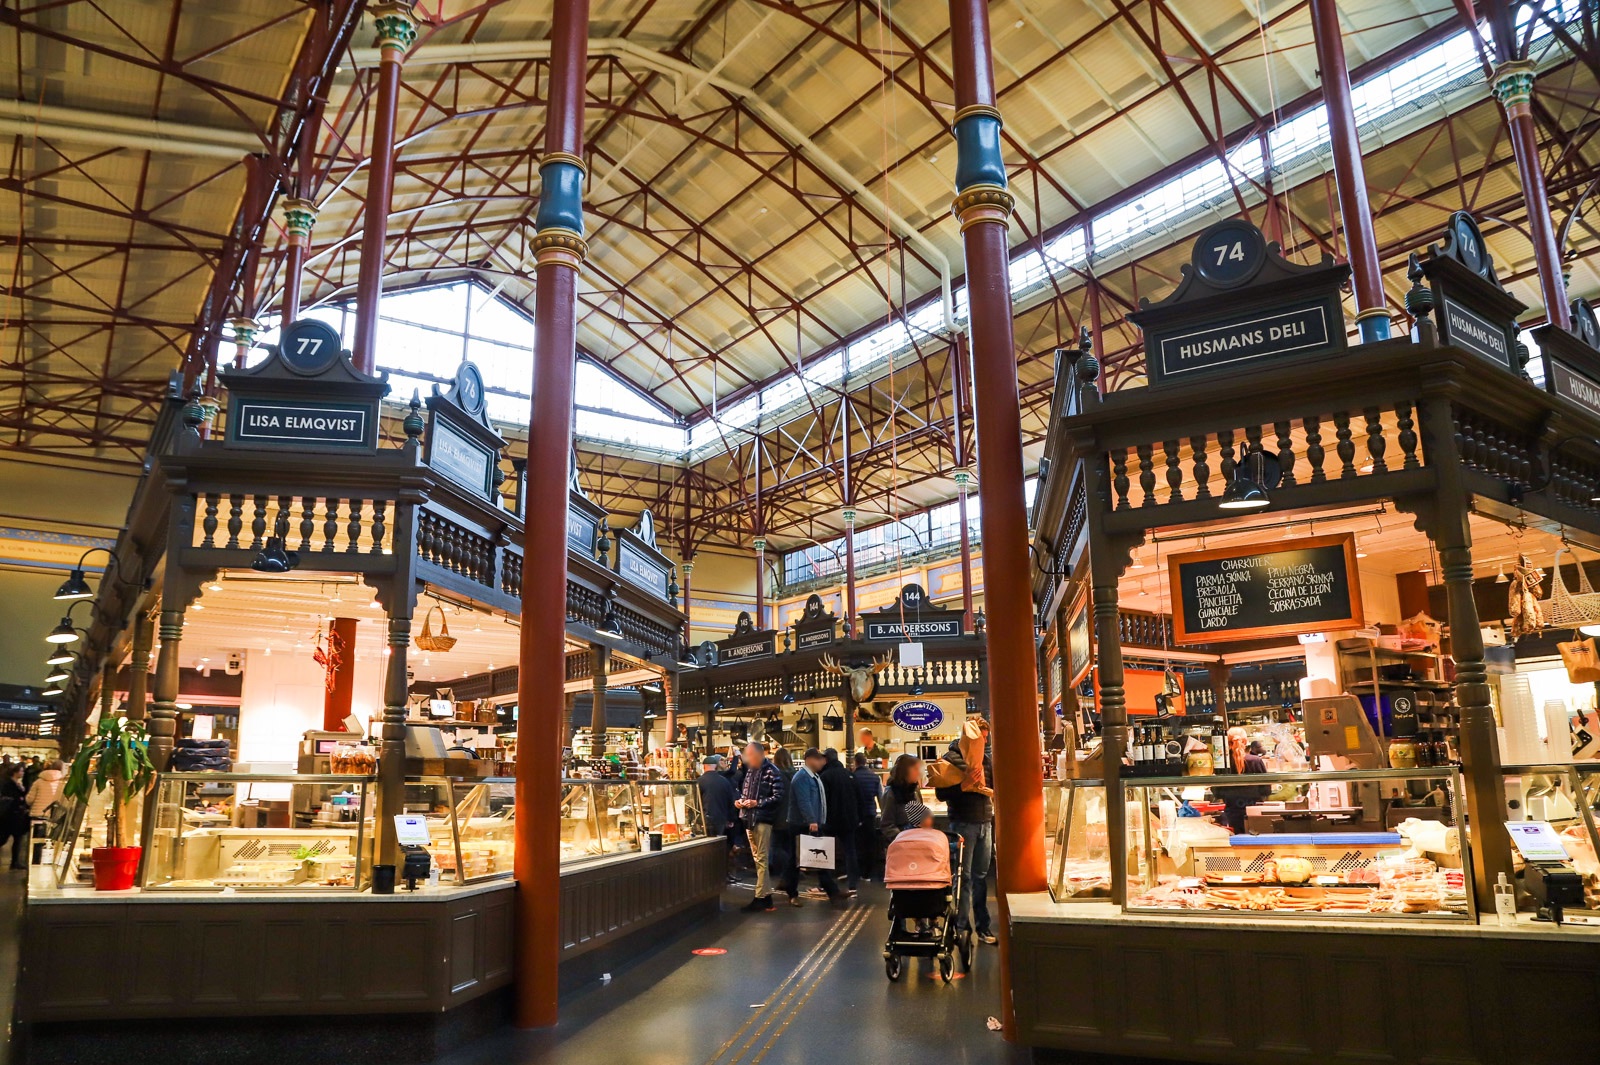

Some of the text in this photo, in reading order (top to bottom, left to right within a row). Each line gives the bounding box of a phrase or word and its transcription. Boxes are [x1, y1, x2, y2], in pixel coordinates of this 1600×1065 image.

[1213, 241, 1245, 265] 74
[1461, 233, 1476, 257] 74
[1450, 312, 1505, 354] HUSMANS DELI
[1582, 316, 1595, 337] 73
[296, 338, 323, 355] 77
[1180, 321, 1306, 359] HUSMANS DELI
[464, 377, 475, 398] 76
[1569, 376, 1600, 410] HUSMA
[250, 415, 356, 431] LISA ELMQVIST
[1196, 573, 1226, 588] PARMA
[1266, 571, 1335, 589] SERRANO SKINKA
[904, 592, 920, 601] 144
[1196, 583, 1237, 598] BRESAOLA
[1268, 582, 1332, 600] CECINA DE LEON
[809, 602, 819, 611] 144
[1198, 593, 1243, 609] PANCHETTA
[1269, 594, 1322, 614] SOBRASSADA
[1198, 604, 1239, 619] GUANCIALE
[877, 623, 951, 634] B. ANDERSSONS
[1200, 616, 1228, 629] LARDO
[733, 643, 764, 656] ANDERSSONS
